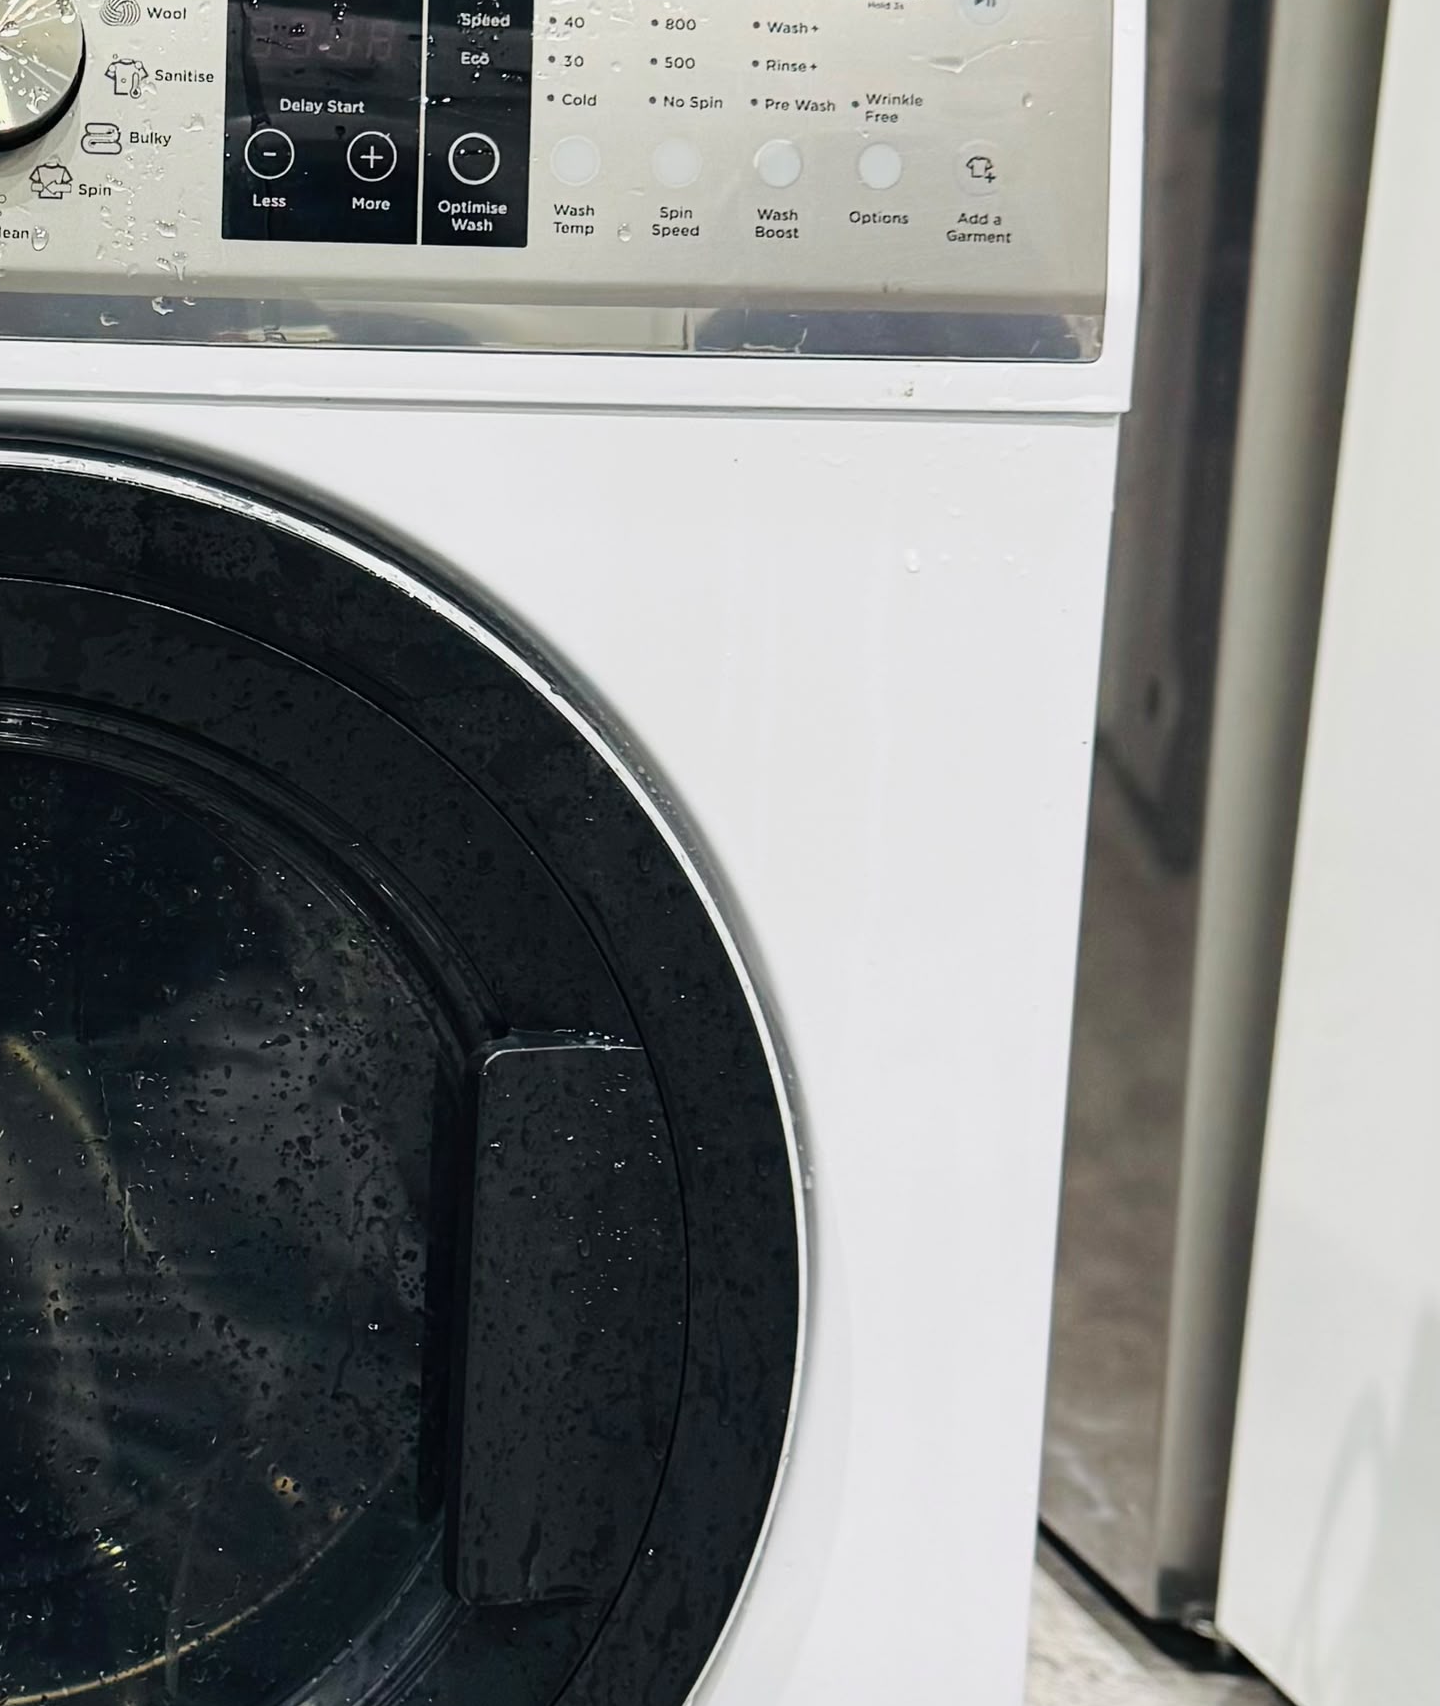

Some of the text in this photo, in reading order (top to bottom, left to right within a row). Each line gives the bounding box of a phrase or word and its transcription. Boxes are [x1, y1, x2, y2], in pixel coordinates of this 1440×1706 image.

[147, 7, 187, 21] Wool
[460, 12, 510, 30] Speed
[564, 16, 585, 29] 40
[665, 18, 697, 31] 800
[460, 52, 490, 65] Eco
[564, 54, 584, 68] 30
[664, 56, 696, 70] 500
[155, 69, 215, 83] Sanitise
[279, 98, 365, 115] Delay Start
[562, 92, 597, 107] Cold
[663, 95, 723, 111] No Spin
[765, 99, 836, 113] Pre Wash
[866, 92, 924, 107] Wrinkle
[865, 110, 898, 123] Free
[130, 131, 172, 148] Bulky
[78, 183, 112, 198] Spin
[252, 193, 286, 208] Less
[352, 196, 391, 211] More
[437, 200, 508, 216] Optimise
[553, 204, 595, 218] Wash
[660, 206, 693, 222] Spin
[757, 208, 799, 222] Wash
[849, 210, 909, 226] Options
[451, 217, 493, 232] Wash
[957, 212, 1002, 226] Add a
[553, 222, 595, 237] Temp
[652, 224, 700, 239] Speed
[755, 226, 799, 239] Boost
[946, 229, 1011, 244] Garment
